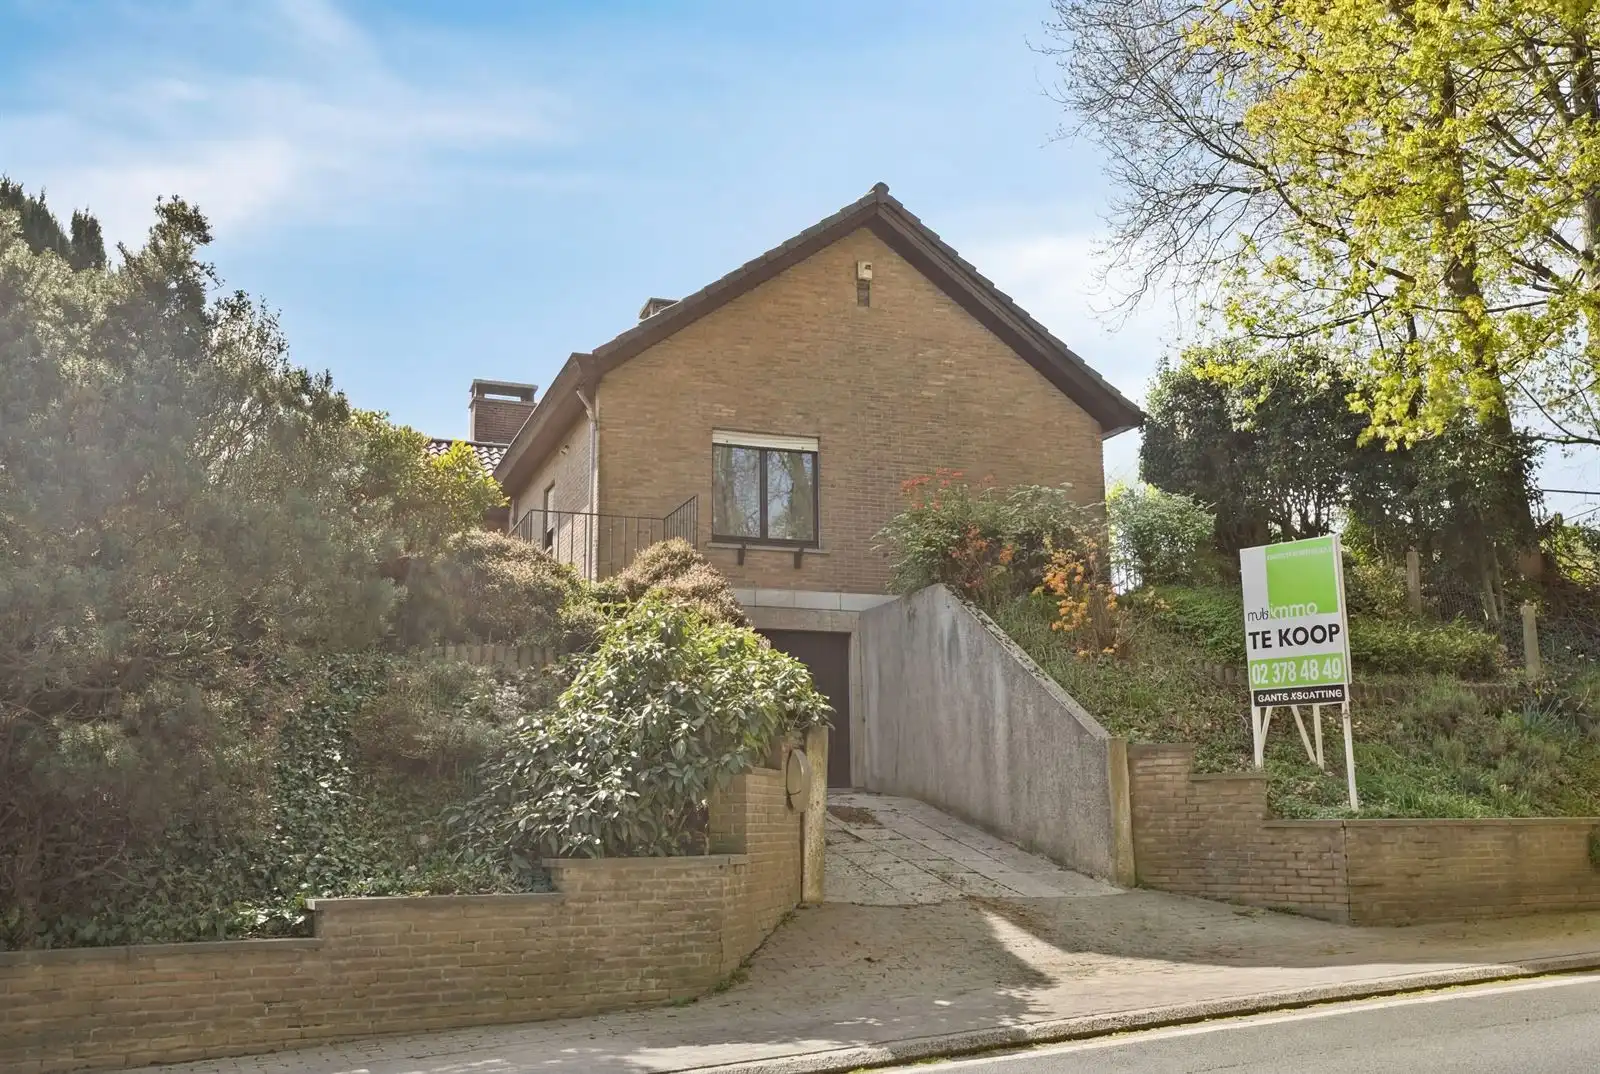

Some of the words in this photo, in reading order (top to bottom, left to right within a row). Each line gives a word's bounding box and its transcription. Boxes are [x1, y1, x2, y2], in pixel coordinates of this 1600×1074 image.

[1248, 630, 1272, 650] TE
[1278, 623, 1341, 647] KOOP
[1252, 663, 1269, 685] 02
[1272, 661, 1297, 684] 378
[1300, 659, 1320, 681] 48
[1322, 657, 1342, 680] 49
